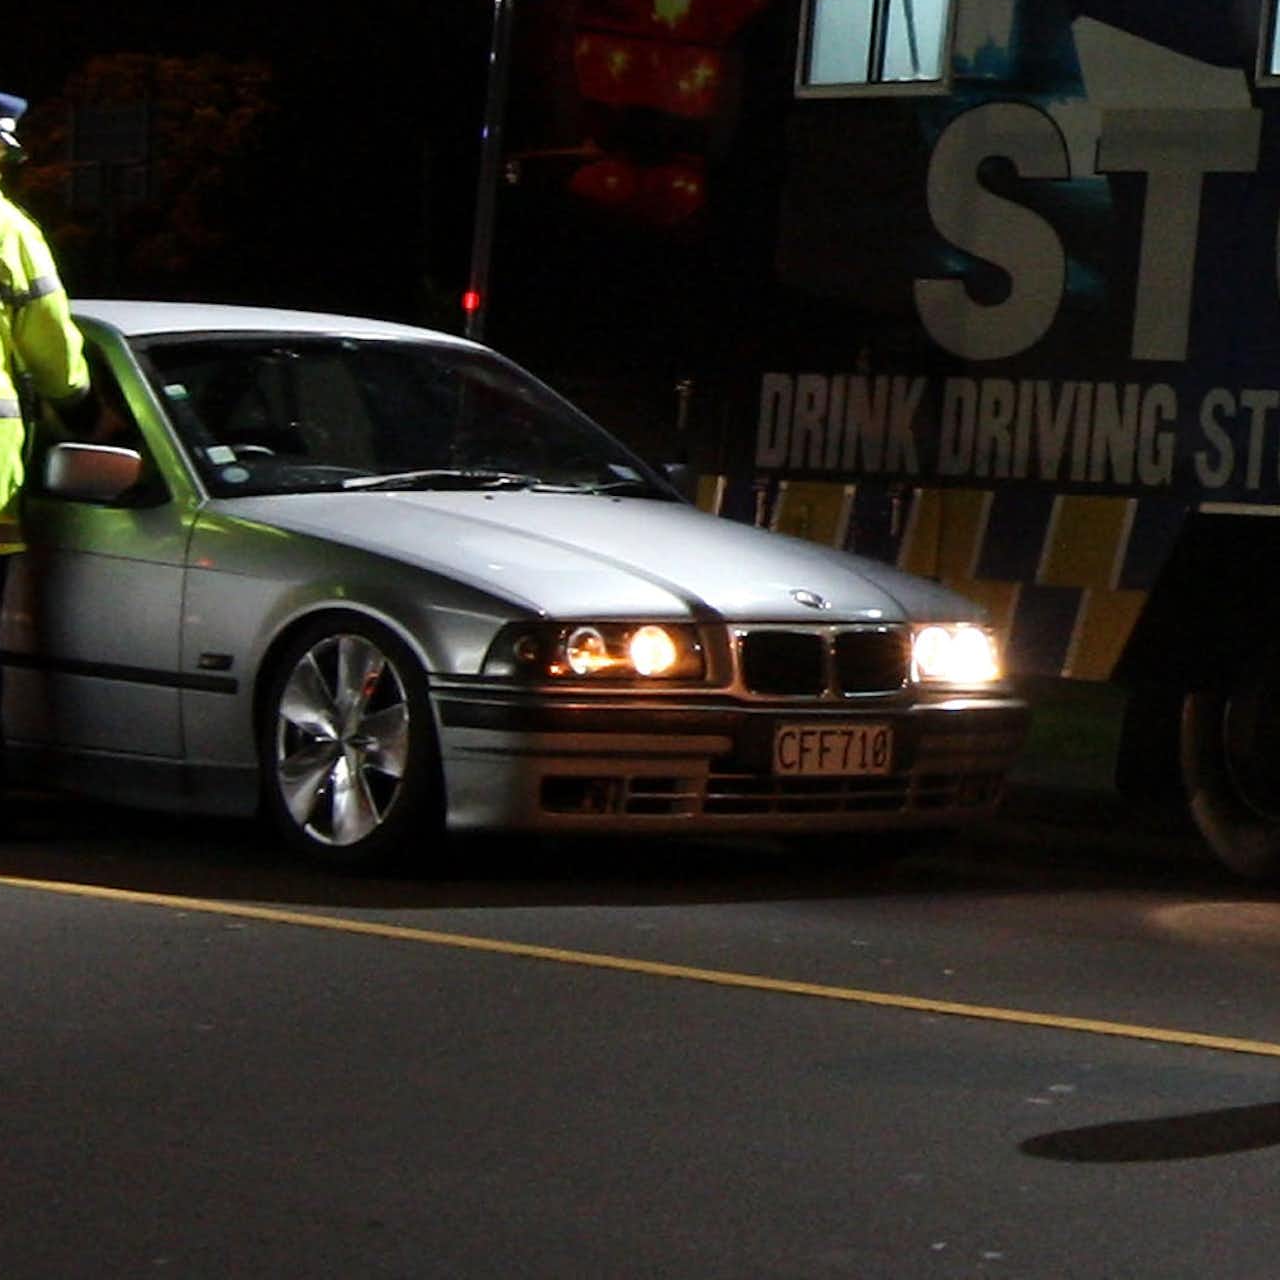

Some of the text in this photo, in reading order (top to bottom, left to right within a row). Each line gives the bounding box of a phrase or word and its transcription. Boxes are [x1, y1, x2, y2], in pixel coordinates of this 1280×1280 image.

[913, 101, 1280, 362] ST
[755, 372, 1280, 490] DRINK DRIVING ST
[779, 730, 887, 770] CFF710
